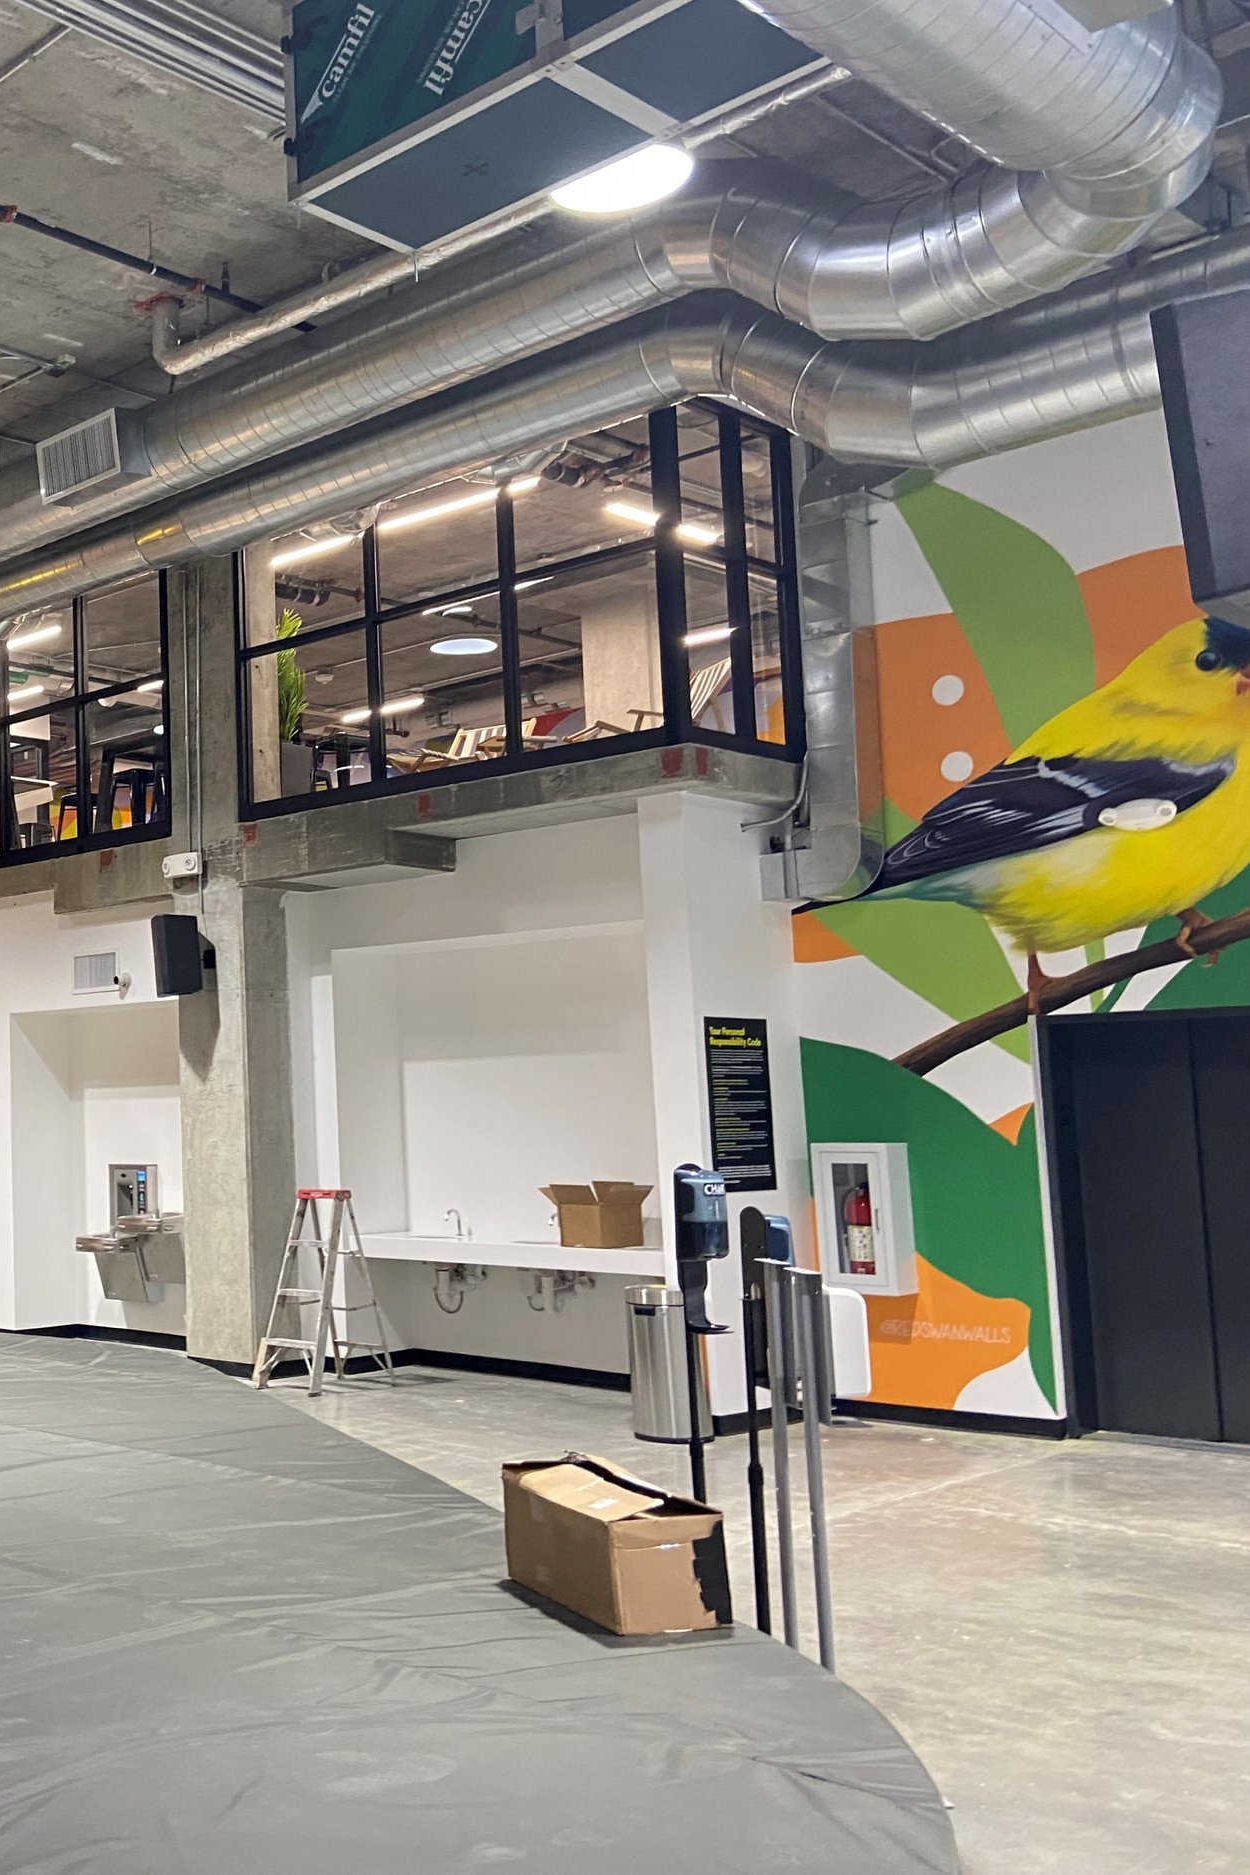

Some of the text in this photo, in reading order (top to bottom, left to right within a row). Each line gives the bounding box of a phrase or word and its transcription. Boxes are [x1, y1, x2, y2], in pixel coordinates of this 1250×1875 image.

[322, 3, 375, 98] camfil
[423, 0, 483, 96] camfil
[709, 1026, 721, 1035] Your
[747, 1037, 762, 1046] Code
